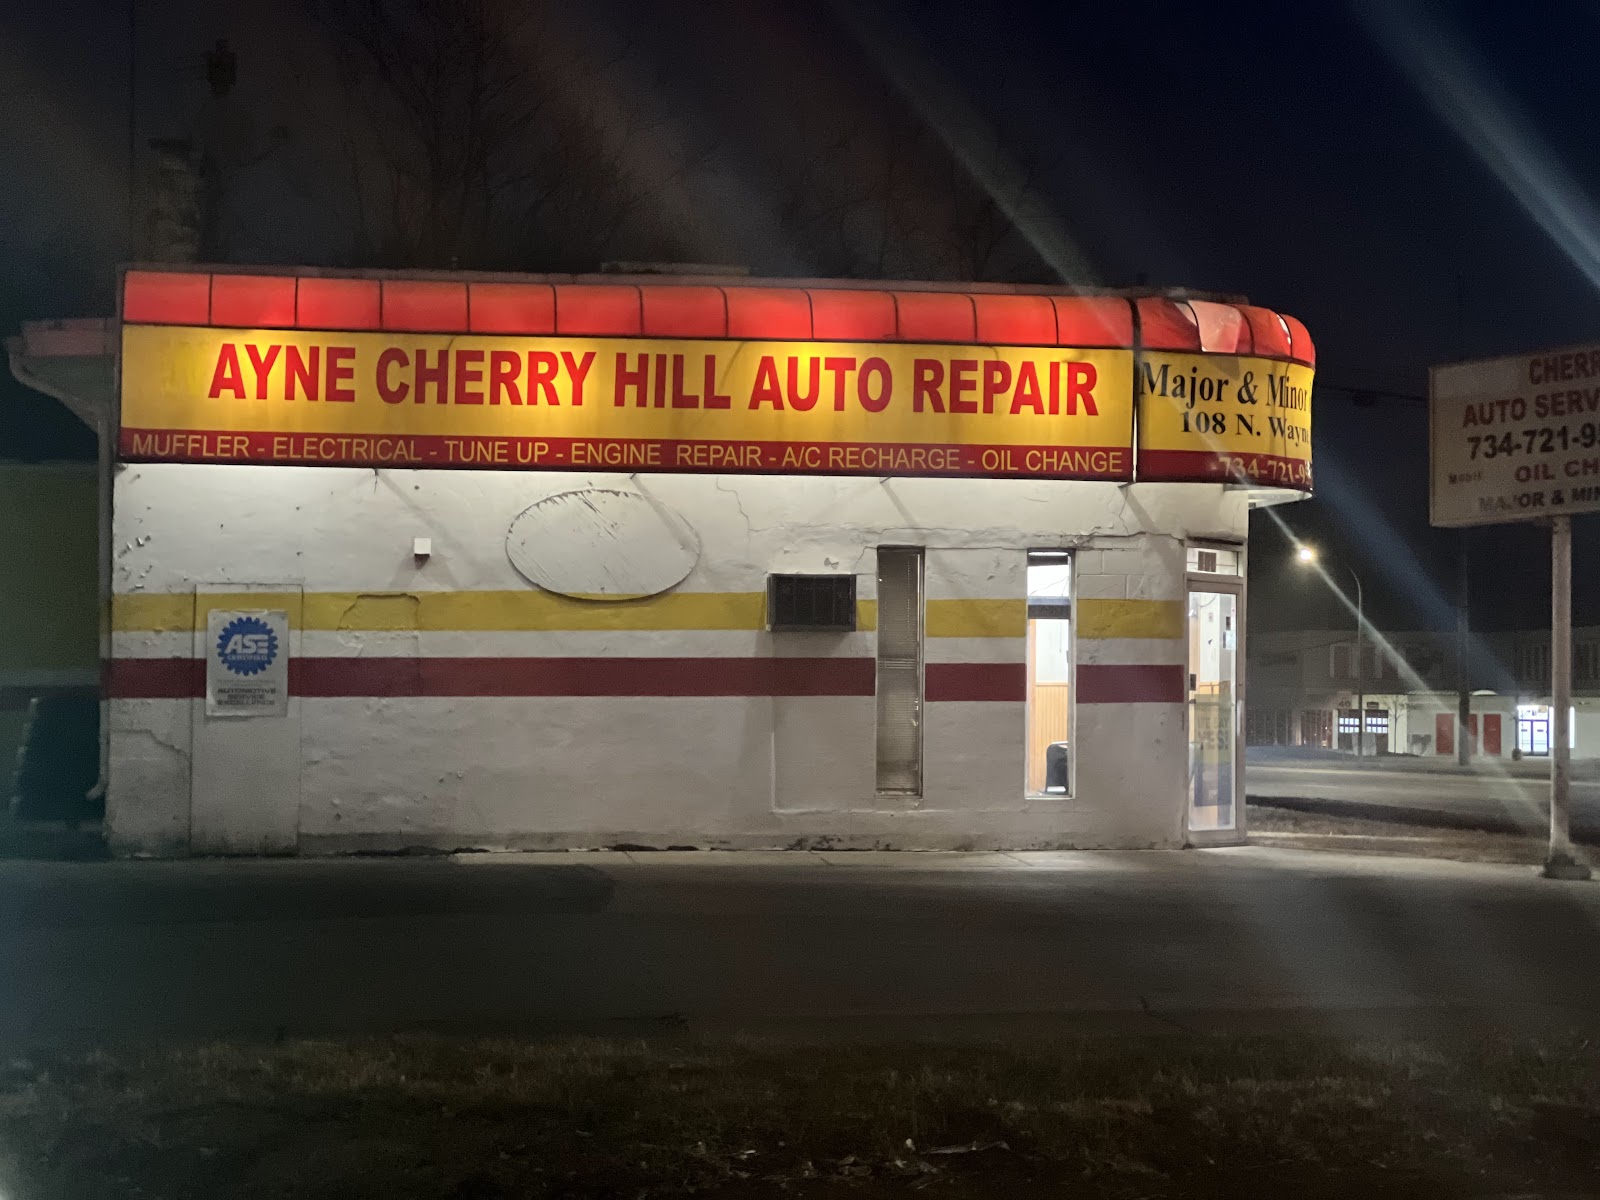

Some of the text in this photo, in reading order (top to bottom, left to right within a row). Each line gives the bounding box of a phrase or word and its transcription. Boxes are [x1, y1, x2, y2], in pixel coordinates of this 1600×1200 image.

[208, 343, 1099, 416] AYNE CHERRY HILL AUTO REPAIR
[1139, 362, 1308, 412] Major & Minor
[1180, 411, 1226, 434] 108
[1236, 413, 1261, 436] N.
[1464, 399, 1526, 426] AUTO
[131, 433, 251, 458] MUFFLER
[273, 436, 422, 462] ELECTRICAL
[444, 439, 509, 463] TUNE
[516, 441, 550, 464] UP
[570, 442, 661, 466] ENGINE
[676, 444, 762, 467] REPAIR
[782, 445, 821, 468] A/C
[828, 446, 961, 471] RECHARGE
[982, 447, 1019, 472] OIL
[1025, 449, 1123, 473] CHANGE
[1467, 422, 1600, 460] 734-721-9
[1515, 465, 1554, 482] OIL
[224, 634, 269, 654] ASE
